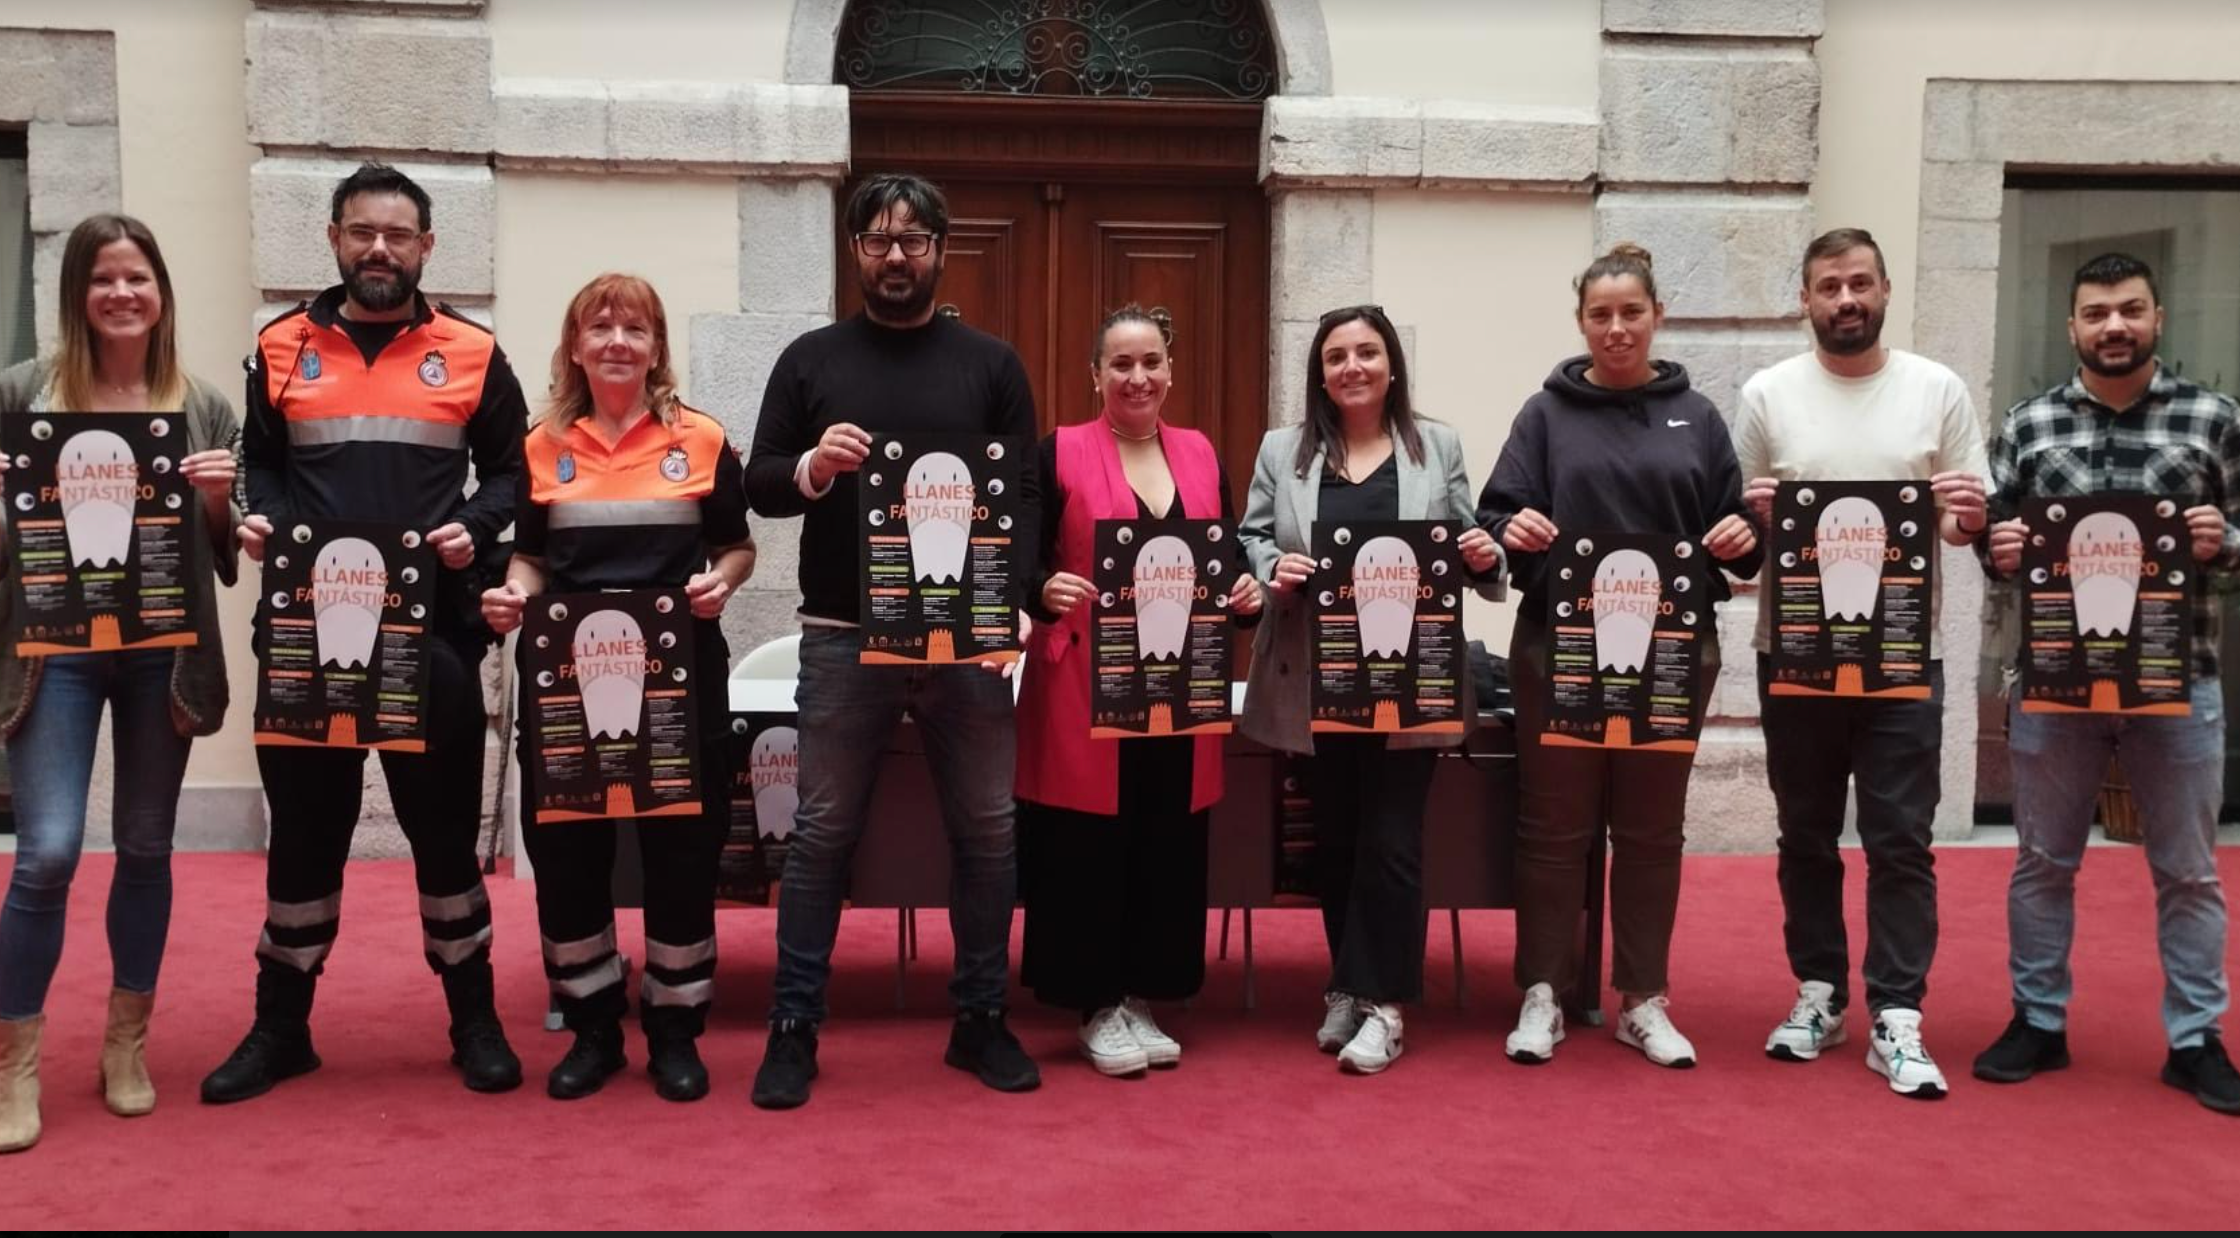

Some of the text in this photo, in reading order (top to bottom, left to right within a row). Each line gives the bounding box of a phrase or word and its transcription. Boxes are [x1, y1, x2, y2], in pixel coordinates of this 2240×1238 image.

[55, 463, 140, 481] LLANES
[904, 483, 976, 500] LLANES
[890, 502, 989, 520] FANTÁSTICO
[1815, 527, 1887, 542] LLANES
[2067, 542, 2144, 557] LLANES
[311, 566, 388, 587] LLANES
[1133, 566, 1197, 581] LLANES
[1351, 566, 1421, 581] LLANES
[1592, 578, 1662, 595] LLANES
[296, 587, 401, 608] FANTÁSTICO
[572, 639, 647, 658] LLANES
[737, 770, 798, 784] FANTÁST
